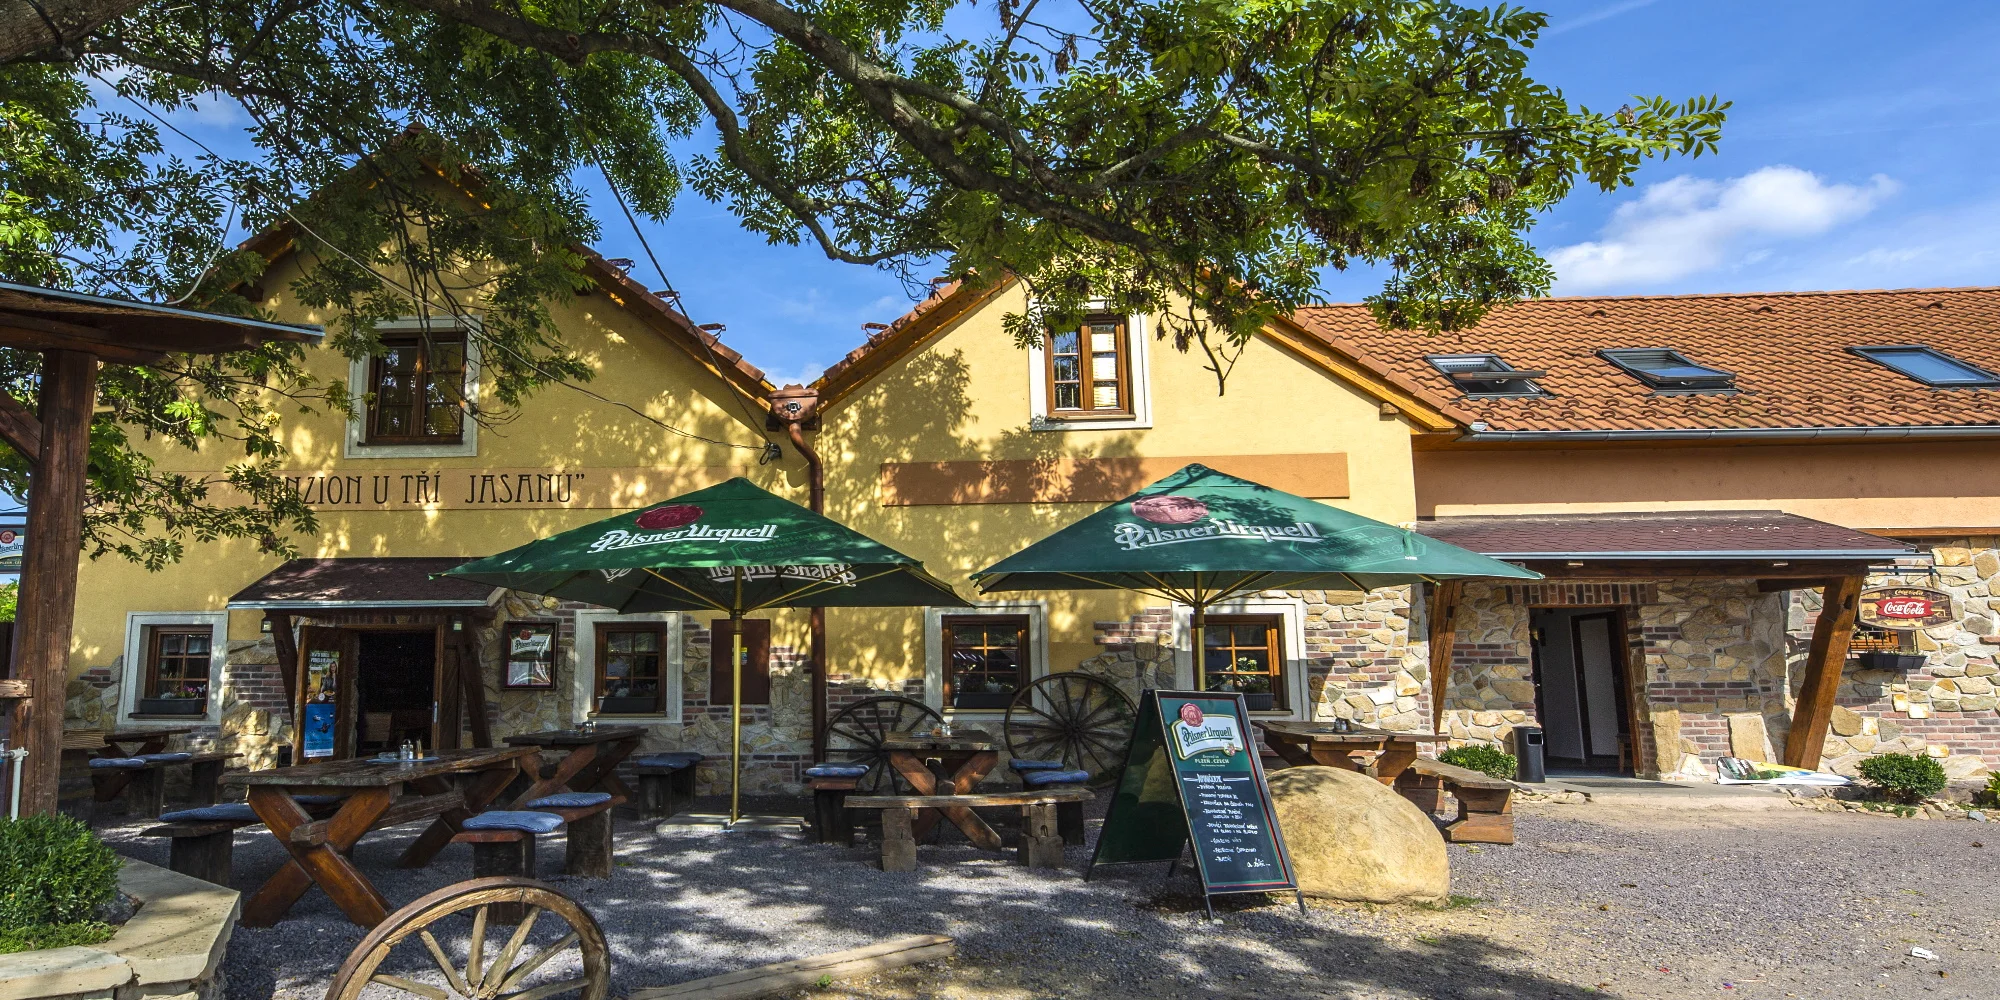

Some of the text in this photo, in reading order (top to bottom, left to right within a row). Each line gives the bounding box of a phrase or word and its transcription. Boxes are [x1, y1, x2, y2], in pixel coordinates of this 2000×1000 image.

[373, 475, 390, 504] U
[400, 470, 441, 504] TŘÍ
[586, 528, 691, 553] Pilsner
[690, 524, 778, 543] Urquell
[1114, 517, 1320, 550] Pilsner Urquell
[1884, 602, 1925, 615] Coca-Cola
[1181, 725, 1233, 747] Pilsner Urquell
